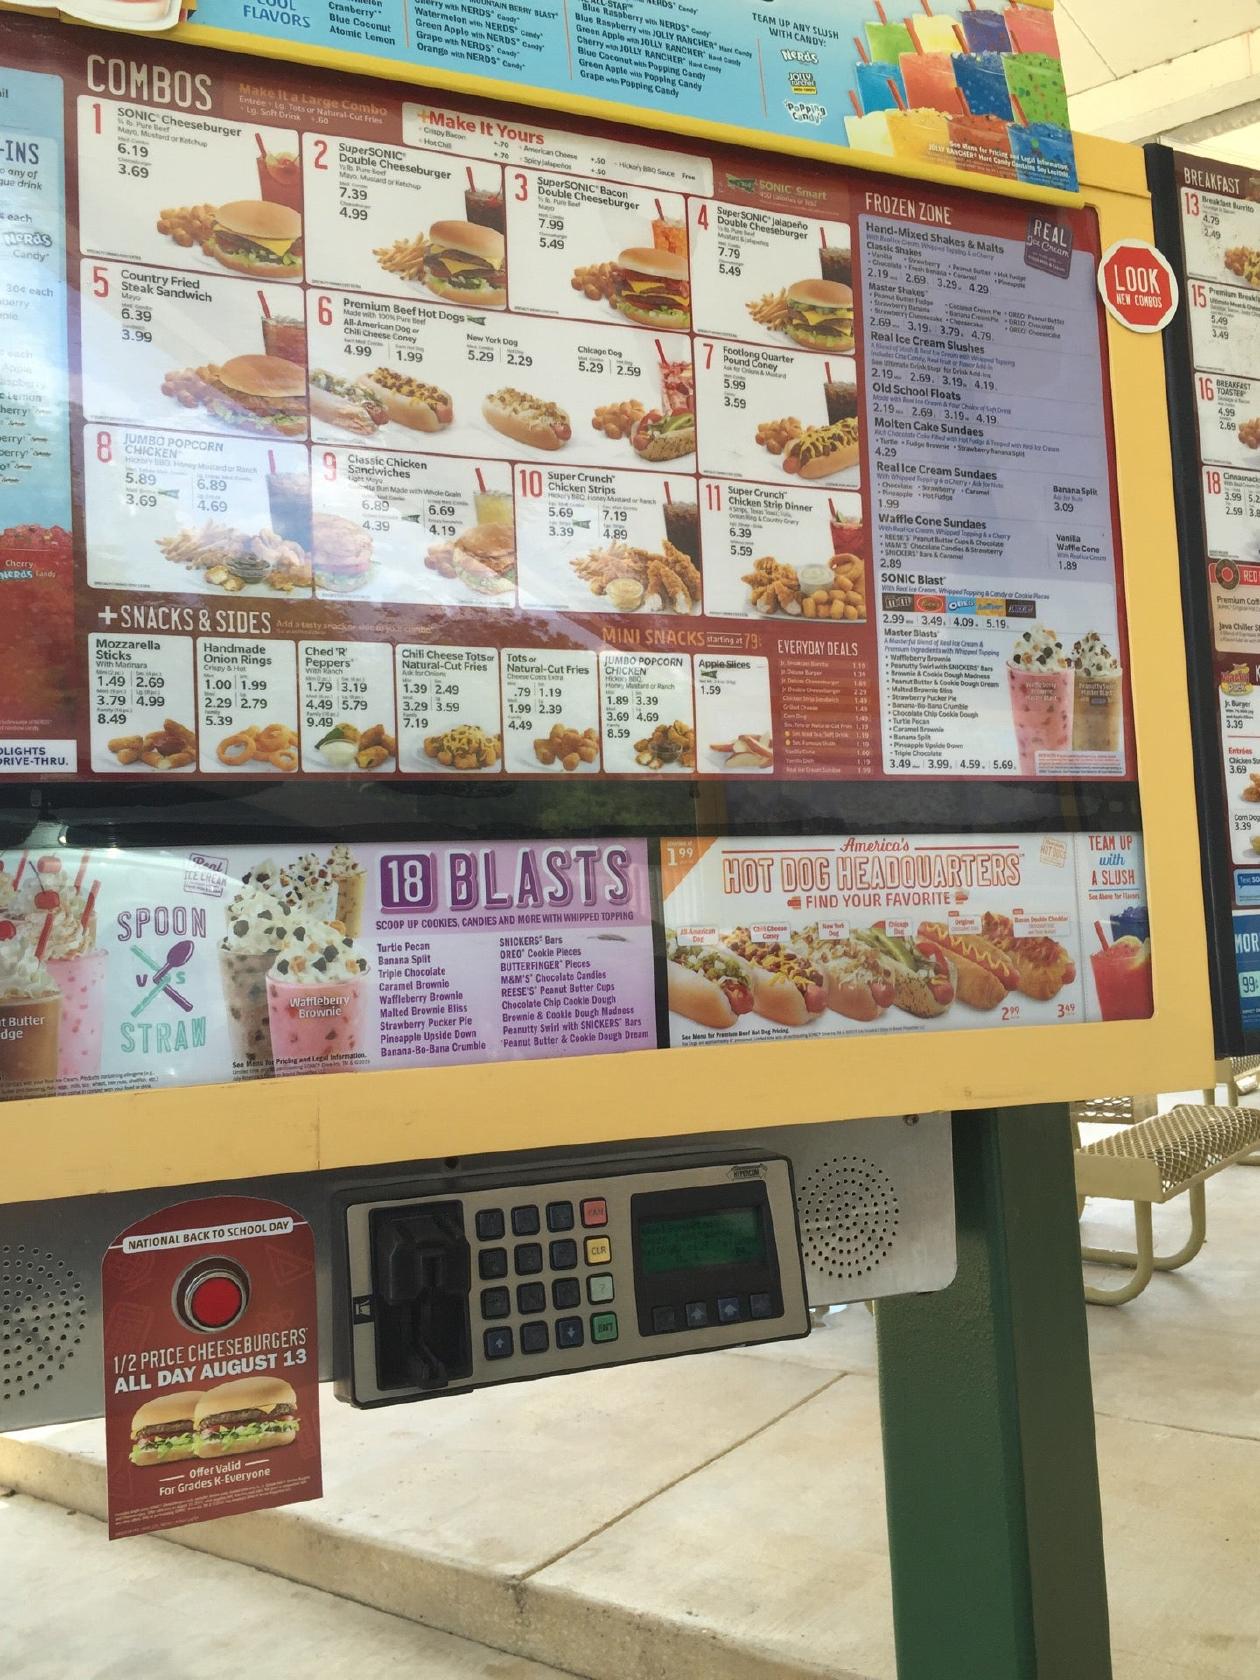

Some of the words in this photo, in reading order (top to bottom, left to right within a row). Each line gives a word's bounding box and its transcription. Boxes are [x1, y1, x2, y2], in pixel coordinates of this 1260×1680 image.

[243, 5, 310, 28] FLAVORS
[329, 14, 352, 26] Blue
[354, 19, 391, 32] Coconut
[329, 26, 362, 39] Atomic
[362, 31, 396, 45] Lemon
[752, 13, 776, 24] TEAM
[778, 17, 790, 25] UP
[794, 20, 811, 31] ANY
[814, 25, 839, 40] SLUSH
[769, 28, 791, 40] WITH
[87, 55, 213, 110] COMBOS
[92, 104, 102, 134] 1
[117, 143, 148, 158] 6.19
[314, 140, 328, 170] 2
[118, 163, 149, 178] 3.69
[339, 154, 377, 167] Double
[380, 161, 452, 180] Cheeseburger
[515, 174, 528, 201] 3
[1184, 168, 1240, 194] BREAKFAST
[339, 188, 368, 200] 7.39
[866, 192, 915, 219] FROZEN
[920, 202, 951, 225] ZONE
[1185, 192, 1199, 216] 13
[339, 208, 368, 220] 4.99
[698, 204, 708, 229] 4
[866, 221, 929, 241] Hand-Mixed
[931, 232, 965, 248] Shakes
[967, 238, 974, 248] &
[977, 240, 1004, 254] Malts
[1033, 219, 1068, 247] REAL
[94, 266, 108, 298] 5
[121, 270, 167, 290] Country
[171, 276, 200, 289] Fried
[1116, 264, 1160, 293] LOOK
[121, 281, 153, 294] Steak
[156, 286, 212, 302] Sandwich
[1116, 293, 1132, 305] NEW
[1135, 295, 1162, 307] COMBOS
[1192, 283, 1206, 308] 15
[121, 309, 152, 322] 6.39
[318, 296, 333, 325] 6
[343, 298, 390, 315] Premium
[394, 304, 416, 318] Beef
[419, 308, 436, 320] Hot
[438, 311, 464, 324] Dogs
[121, 329, 152, 342] 3.99
[467, 333, 482, 342] New
[484, 336, 500, 344] York
[502, 338, 518, 348] Dog
[871, 331, 894, 344] Real
[896, 335, 910, 345] Ice
[913, 337, 946, 350] Cream
[948, 340, 984, 355] Slushes
[703, 344, 714, 369] 7
[723, 346, 759, 363] Footlong
[760, 353, 794, 365] Quarter
[1198, 376, 1214, 400] 16
[97, 431, 112, 463] 8
[124, 433, 165, 448] JUMBO
[167, 436, 224, 452] POPCORN
[323, 452, 336, 481] 9
[520, 470, 542, 497] 10
[548, 483, 586, 493] Chicken
[588, 485, 615, 496] Strips
[1207, 471, 1221, 494] 18
[705, 484, 721, 511] 11
[729, 497, 759, 510] Chicken
[762, 501, 779, 513] Strip
[781, 503, 812, 513] Dinner
[879, 513, 914, 525] Waffle
[916, 515, 942, 527] Cone
[944, 518, 986, 530] Sundaes
[199, 612, 211, 631] &
[216, 612, 272, 634] SIDES
[96, 638, 160, 650] Mozzarella
[602, 627, 640, 645] MINI
[644, 629, 705, 646] SNACKS
[96, 650, 132, 661] Sticks
[204, 643, 266, 655] Handmade
[778, 640, 825, 655] EVERYDAY
[828, 643, 858, 656] DEALS
[203, 654, 237, 665] Onion
[241, 655, 272, 666] Rings
[97, 676, 125, 687] 1.49
[136, 677, 164, 688] 2.69
[889, 760, 911, 769] 3.49
[928, 760, 949, 770] 3.99
[960, 760, 981, 770] 4.59
[993, 760, 1013, 770] 5.69
[839, 837, 909, 853] America's
[1087, 834, 1115, 851] TEAM
[1119, 836, 1132, 851] UP
[1099, 852, 1126, 867] with
[388, 860, 423, 903] 18
[448, 845, 631, 911] BLASTS
[723, 857, 773, 893] HOT
[781, 855, 829, 891] DOG
[836, 853, 1022, 889] HEADQUARTERS
[1090, 871, 1098, 886] A
[1101, 869, 1135, 887] SLUSH
[805, 893, 839, 909] FIND
[843, 893, 882, 908] YOUR
[886, 891, 951, 907] FAVORITE
[117, 906, 206, 942] SPOON
[376, 920, 404, 930] SCOOP
[407, 920, 419, 928] UP
[421, 918, 460, 929] COOKIES,
[462, 916, 497, 926] CANDIES
[499, 915, 515, 925] AND
[518, 914, 541, 924] MORE
[542, 913, 562, 923] WITH
[563, 912, 599, 922] WHIPPED
[601, 911, 634, 921] TOPPING
[377, 942, 403, 952] Turtle
[405, 942, 430, 951] Pecan
[378, 955, 408, 965] Banana
[411, 954, 431, 965] Split
[378, 969, 402, 978] Triple
[405, 967, 445, 977] Chocolate
[289, 996, 350, 1010] Waffleberry
[501, 998, 542, 1010] Chocolate
[545, 997, 562, 1009] Chip
[563, 996, 590, 1006] Cookie
[592, 995, 616, 1006] Dough
[8, 1015, 45, 1027] Butter
[298, 1006, 342, 1020] Brownie
[120, 1016, 206, 1053] STRAW
[128, 1234, 181, 1250] NATIONAL
[183, 1230, 209, 1243] BACK
[211, 1228, 225, 1239] TO
[227, 1224, 267, 1237] SCHOOL
[269, 1220, 289, 1231] DAY
[114, 1354, 136, 1374] 1/2
[141, 1346, 184, 1371] PRICE
[188, 1328, 307, 1362] CHEESEBURGERS
[115, 1373, 152, 1394] ALL
[157, 1367, 196, 1386] DAY
[200, 1354, 277, 1379] AUGUST
[283, 1349, 307, 1365] 13
[190, 1466, 214, 1478] Offer
[215, 1460, 241, 1474] Valid
[160, 1484, 175, 1495] For
[178, 1478, 213, 1493] Grades
[214, 1468, 270, 1486] K-Everyone
